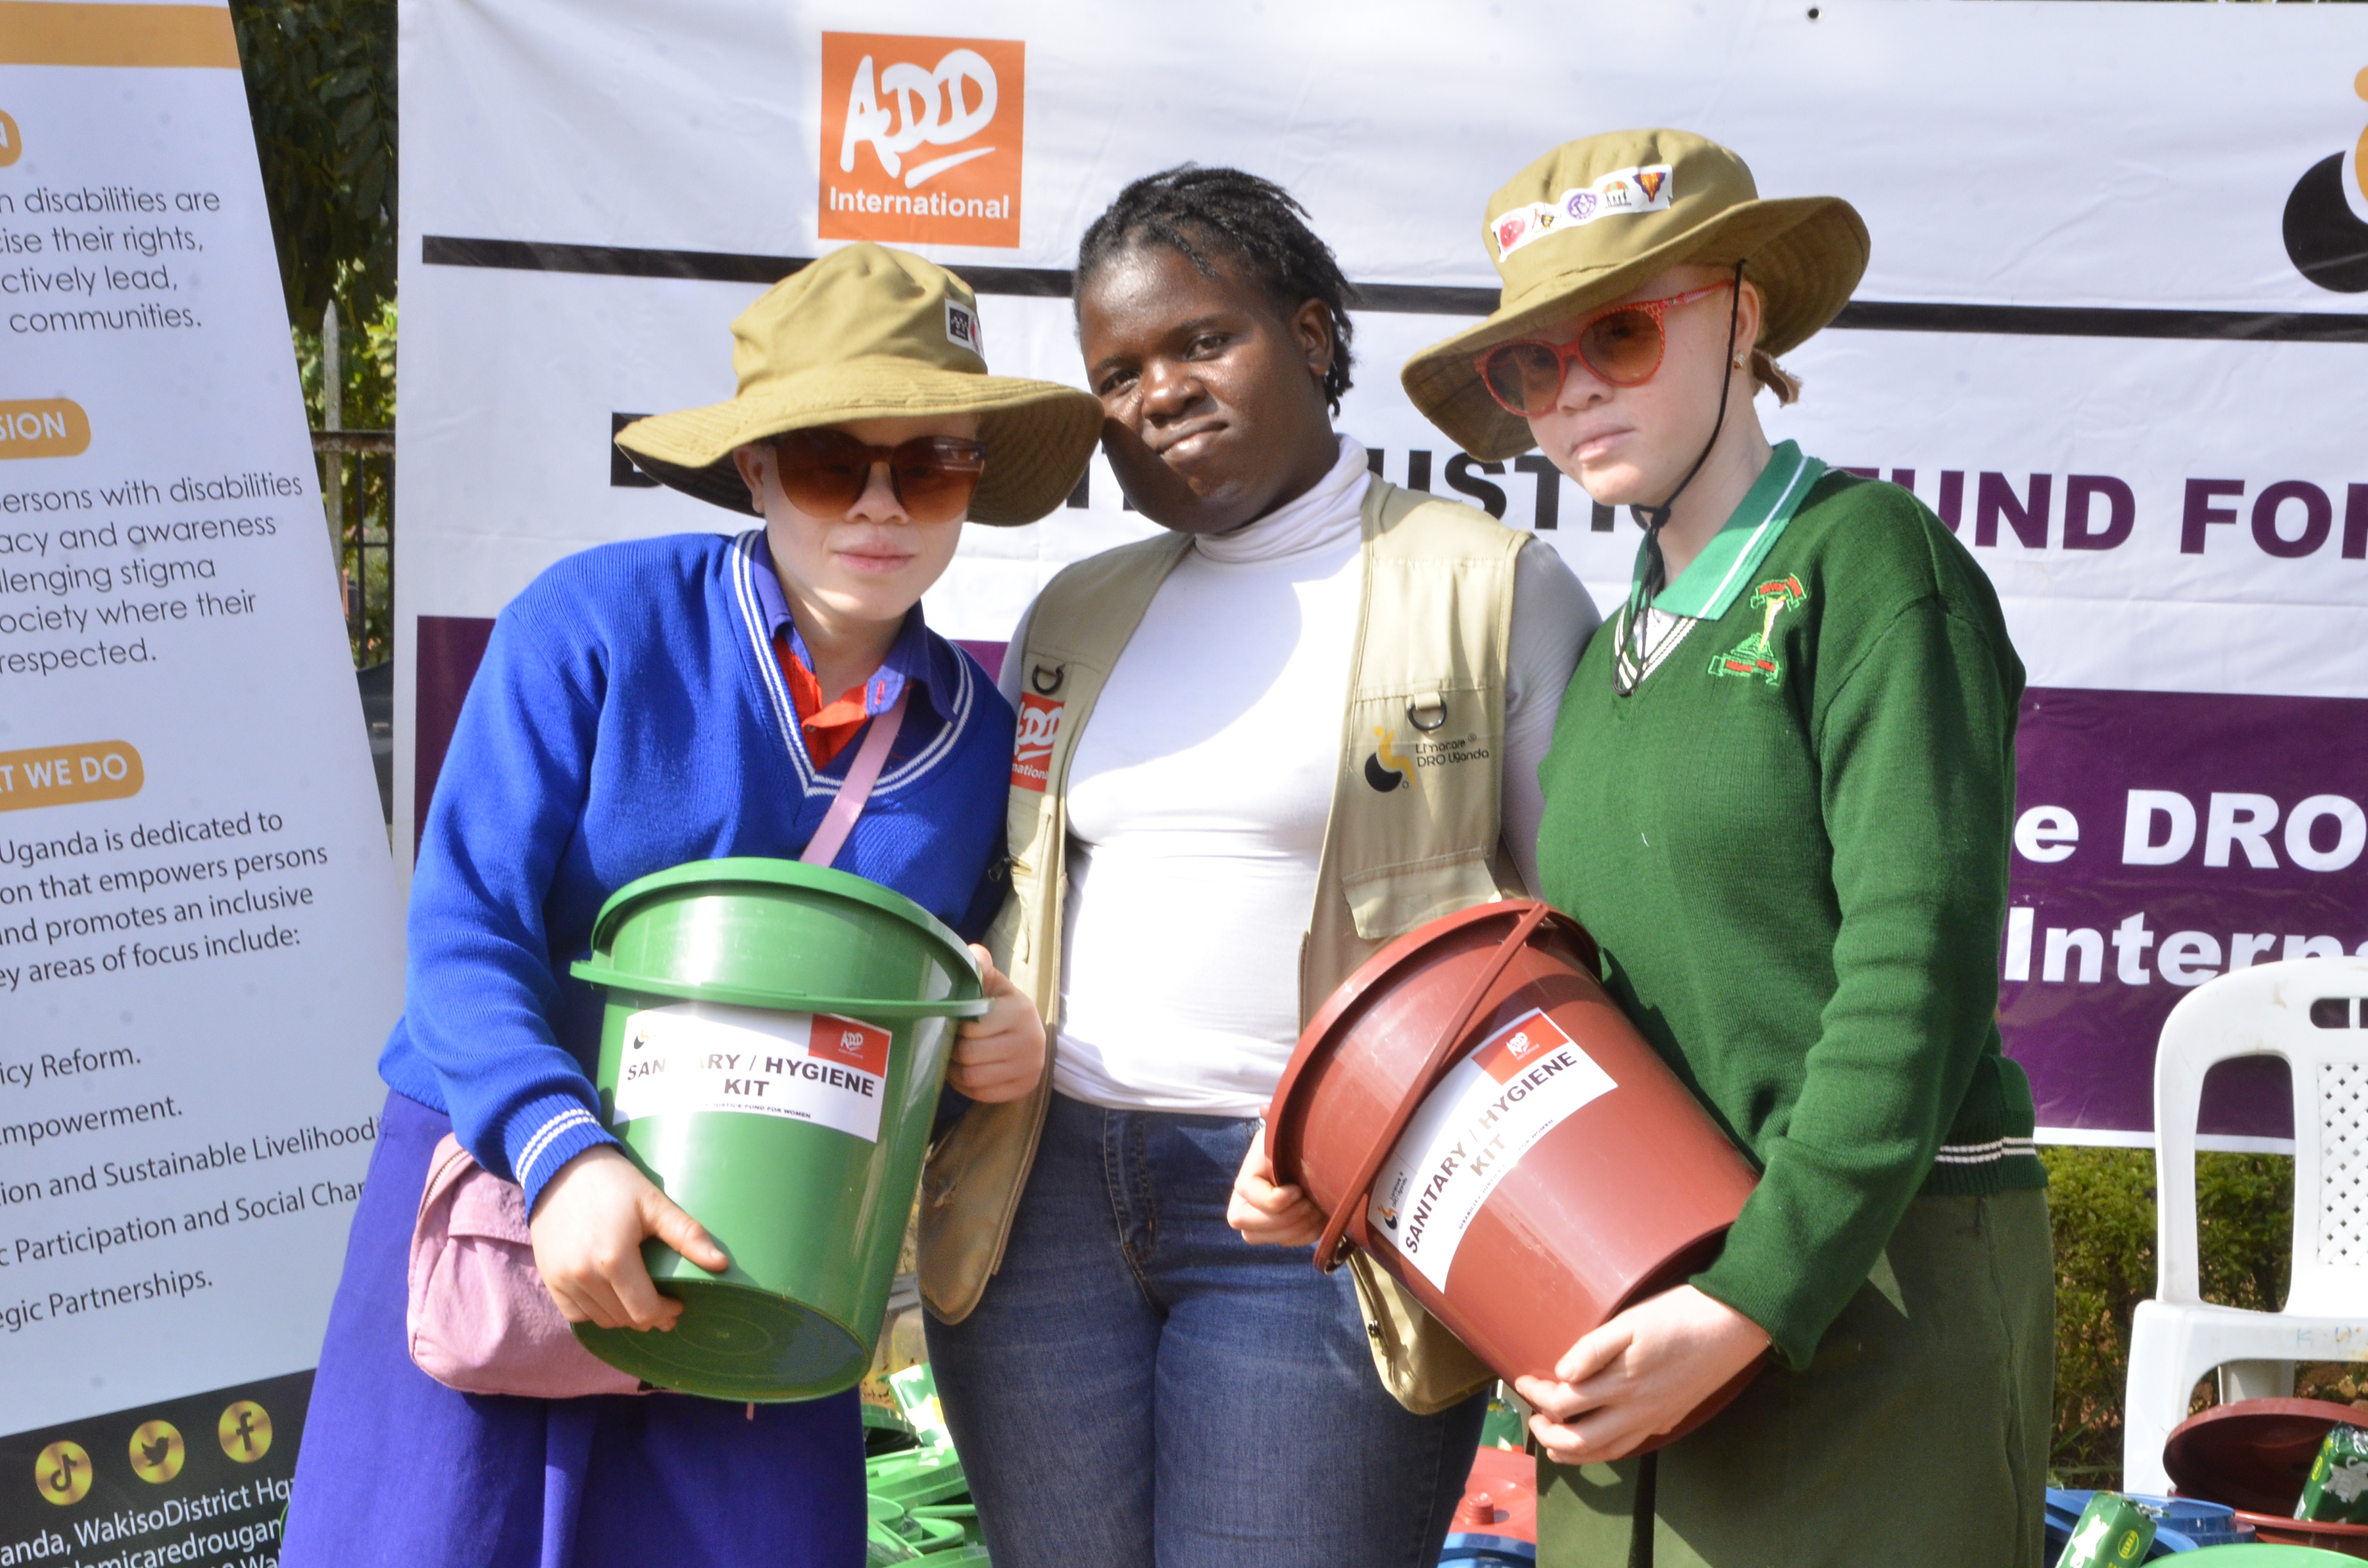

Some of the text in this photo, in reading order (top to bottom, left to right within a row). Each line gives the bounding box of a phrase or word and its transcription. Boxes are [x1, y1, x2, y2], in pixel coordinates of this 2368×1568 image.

[840, 49, 998, 179] ADD
[24, 187, 167, 213] disabilities
[176, 193, 219, 211] are
[830, 186, 1008, 219] International
[0, 225, 202, 257] ise their rights,
[104, 265, 176, 290] lead,
[10, 303, 201, 332] communities.
[0, 472, 302, 513] ersons with disabilities
[60, 521, 117, 550] and
[127, 517, 275, 548] awareness
[0, 559, 215, 596] lenging stigma
[0, 589, 256, 633] ociety where their
[0, 637, 156, 676] respected.
[24, 760, 71, 788] WE
[81, 755, 127, 782] DO
[1417, 754, 1446, 767] DRO
[0, 811, 283, 868] Uganda is dedicated to
[2122, 789, 2367, 872] DRO
[0, 847, 327, 904] on that empowers persons
[0, 886, 313, 945] nd promotes an inclusive
[29, 957, 95, 982] areas
[103, 945, 126, 971] of
[133, 943, 198, 967] focus
[204, 924, 300, 957] include:
[41, 1049, 140, 1078] Reform.
[627, 1054, 741, 1081] SANRY
[765, 1056, 875, 1098] HYGIENE
[723, 1079, 769, 1097] KIT
[0, 1097, 182, 1147] mpowerment.
[784, 1108, 811, 1118] WOMEN
[1, 1115, 382, 1205] ion and Sustainable Livelihood
[1406, 1141, 1467, 1254] SANITARY
[1478, 1052, 1577, 1130] HYGIENE
[1470, 1134, 1505, 1177] KIT
[15, 1218, 176, 1262] Participation
[184, 1200, 229, 1231] and
[236, 1186, 305, 1221] Social
[49, 1270, 212, 1317] Partnerships.
[1, 1530, 70, 1566] anda,
[256, 1476, 295, 1505] Hq
